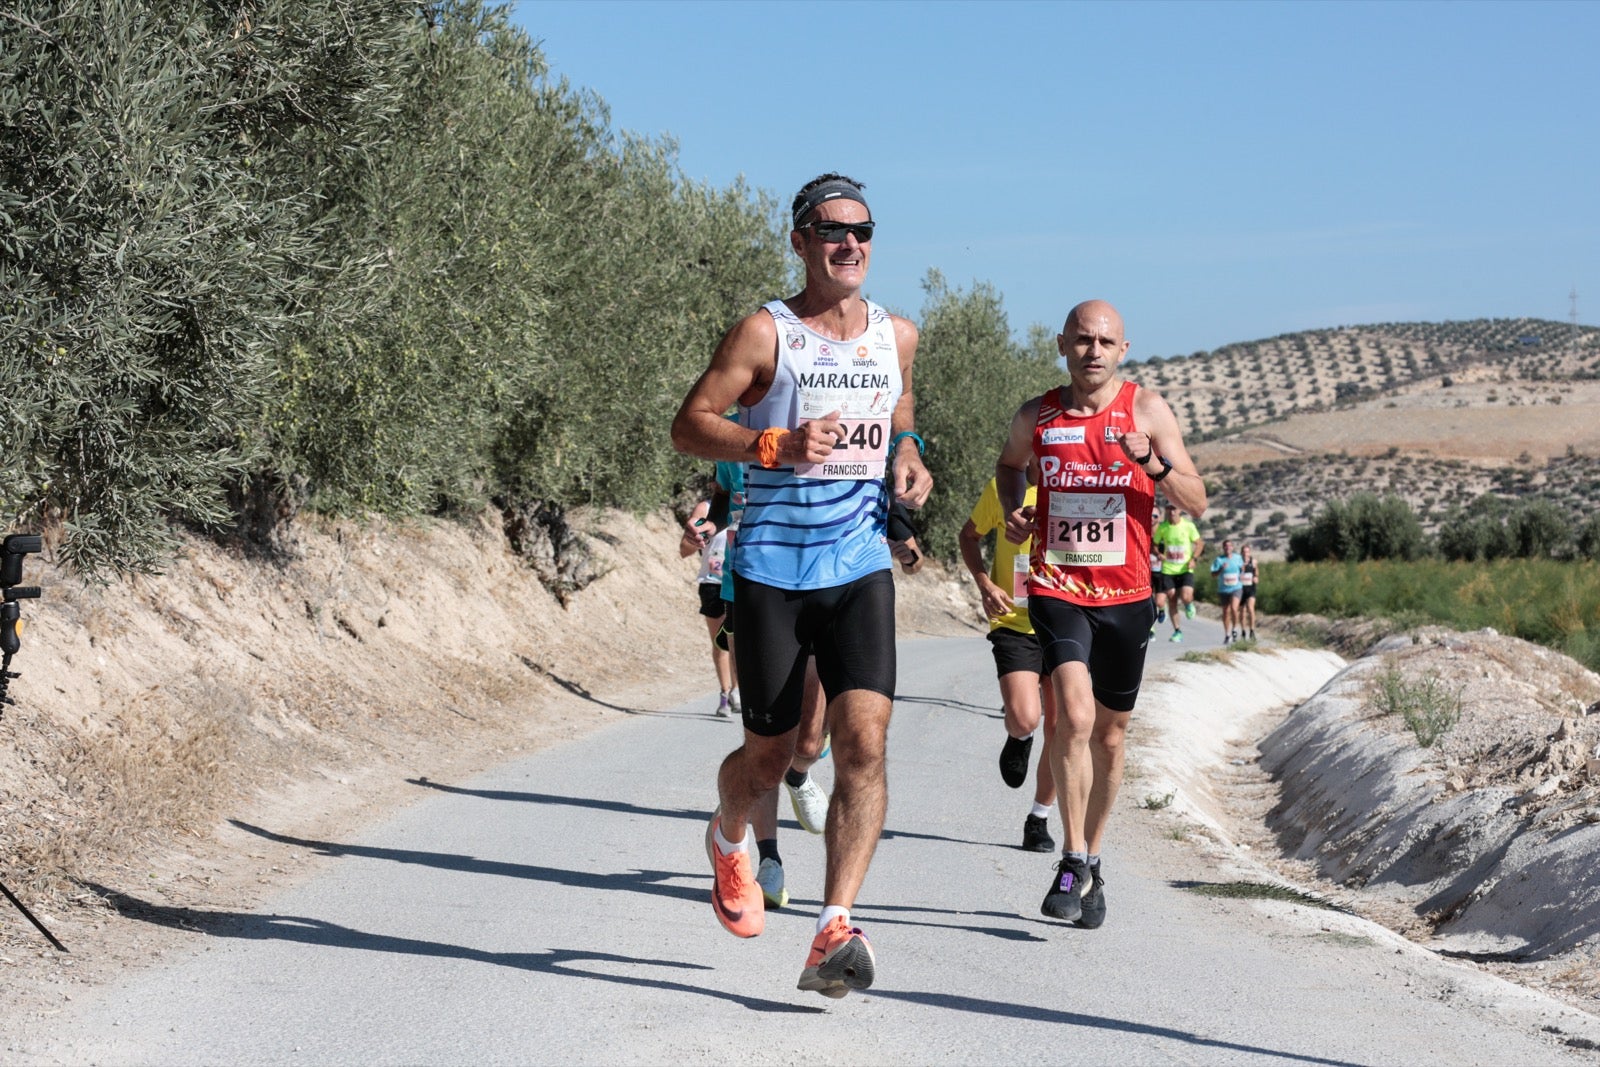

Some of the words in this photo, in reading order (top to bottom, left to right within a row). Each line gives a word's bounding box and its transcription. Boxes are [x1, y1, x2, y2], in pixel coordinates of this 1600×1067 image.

[799, 373, 889, 388] MARACENA
[823, 464, 868, 476] FRANCISCO
[1040, 456, 1133, 487] Polisalud
[1058, 521, 1114, 542] 2181
[1065, 553, 1103, 563] FRANCISCO
